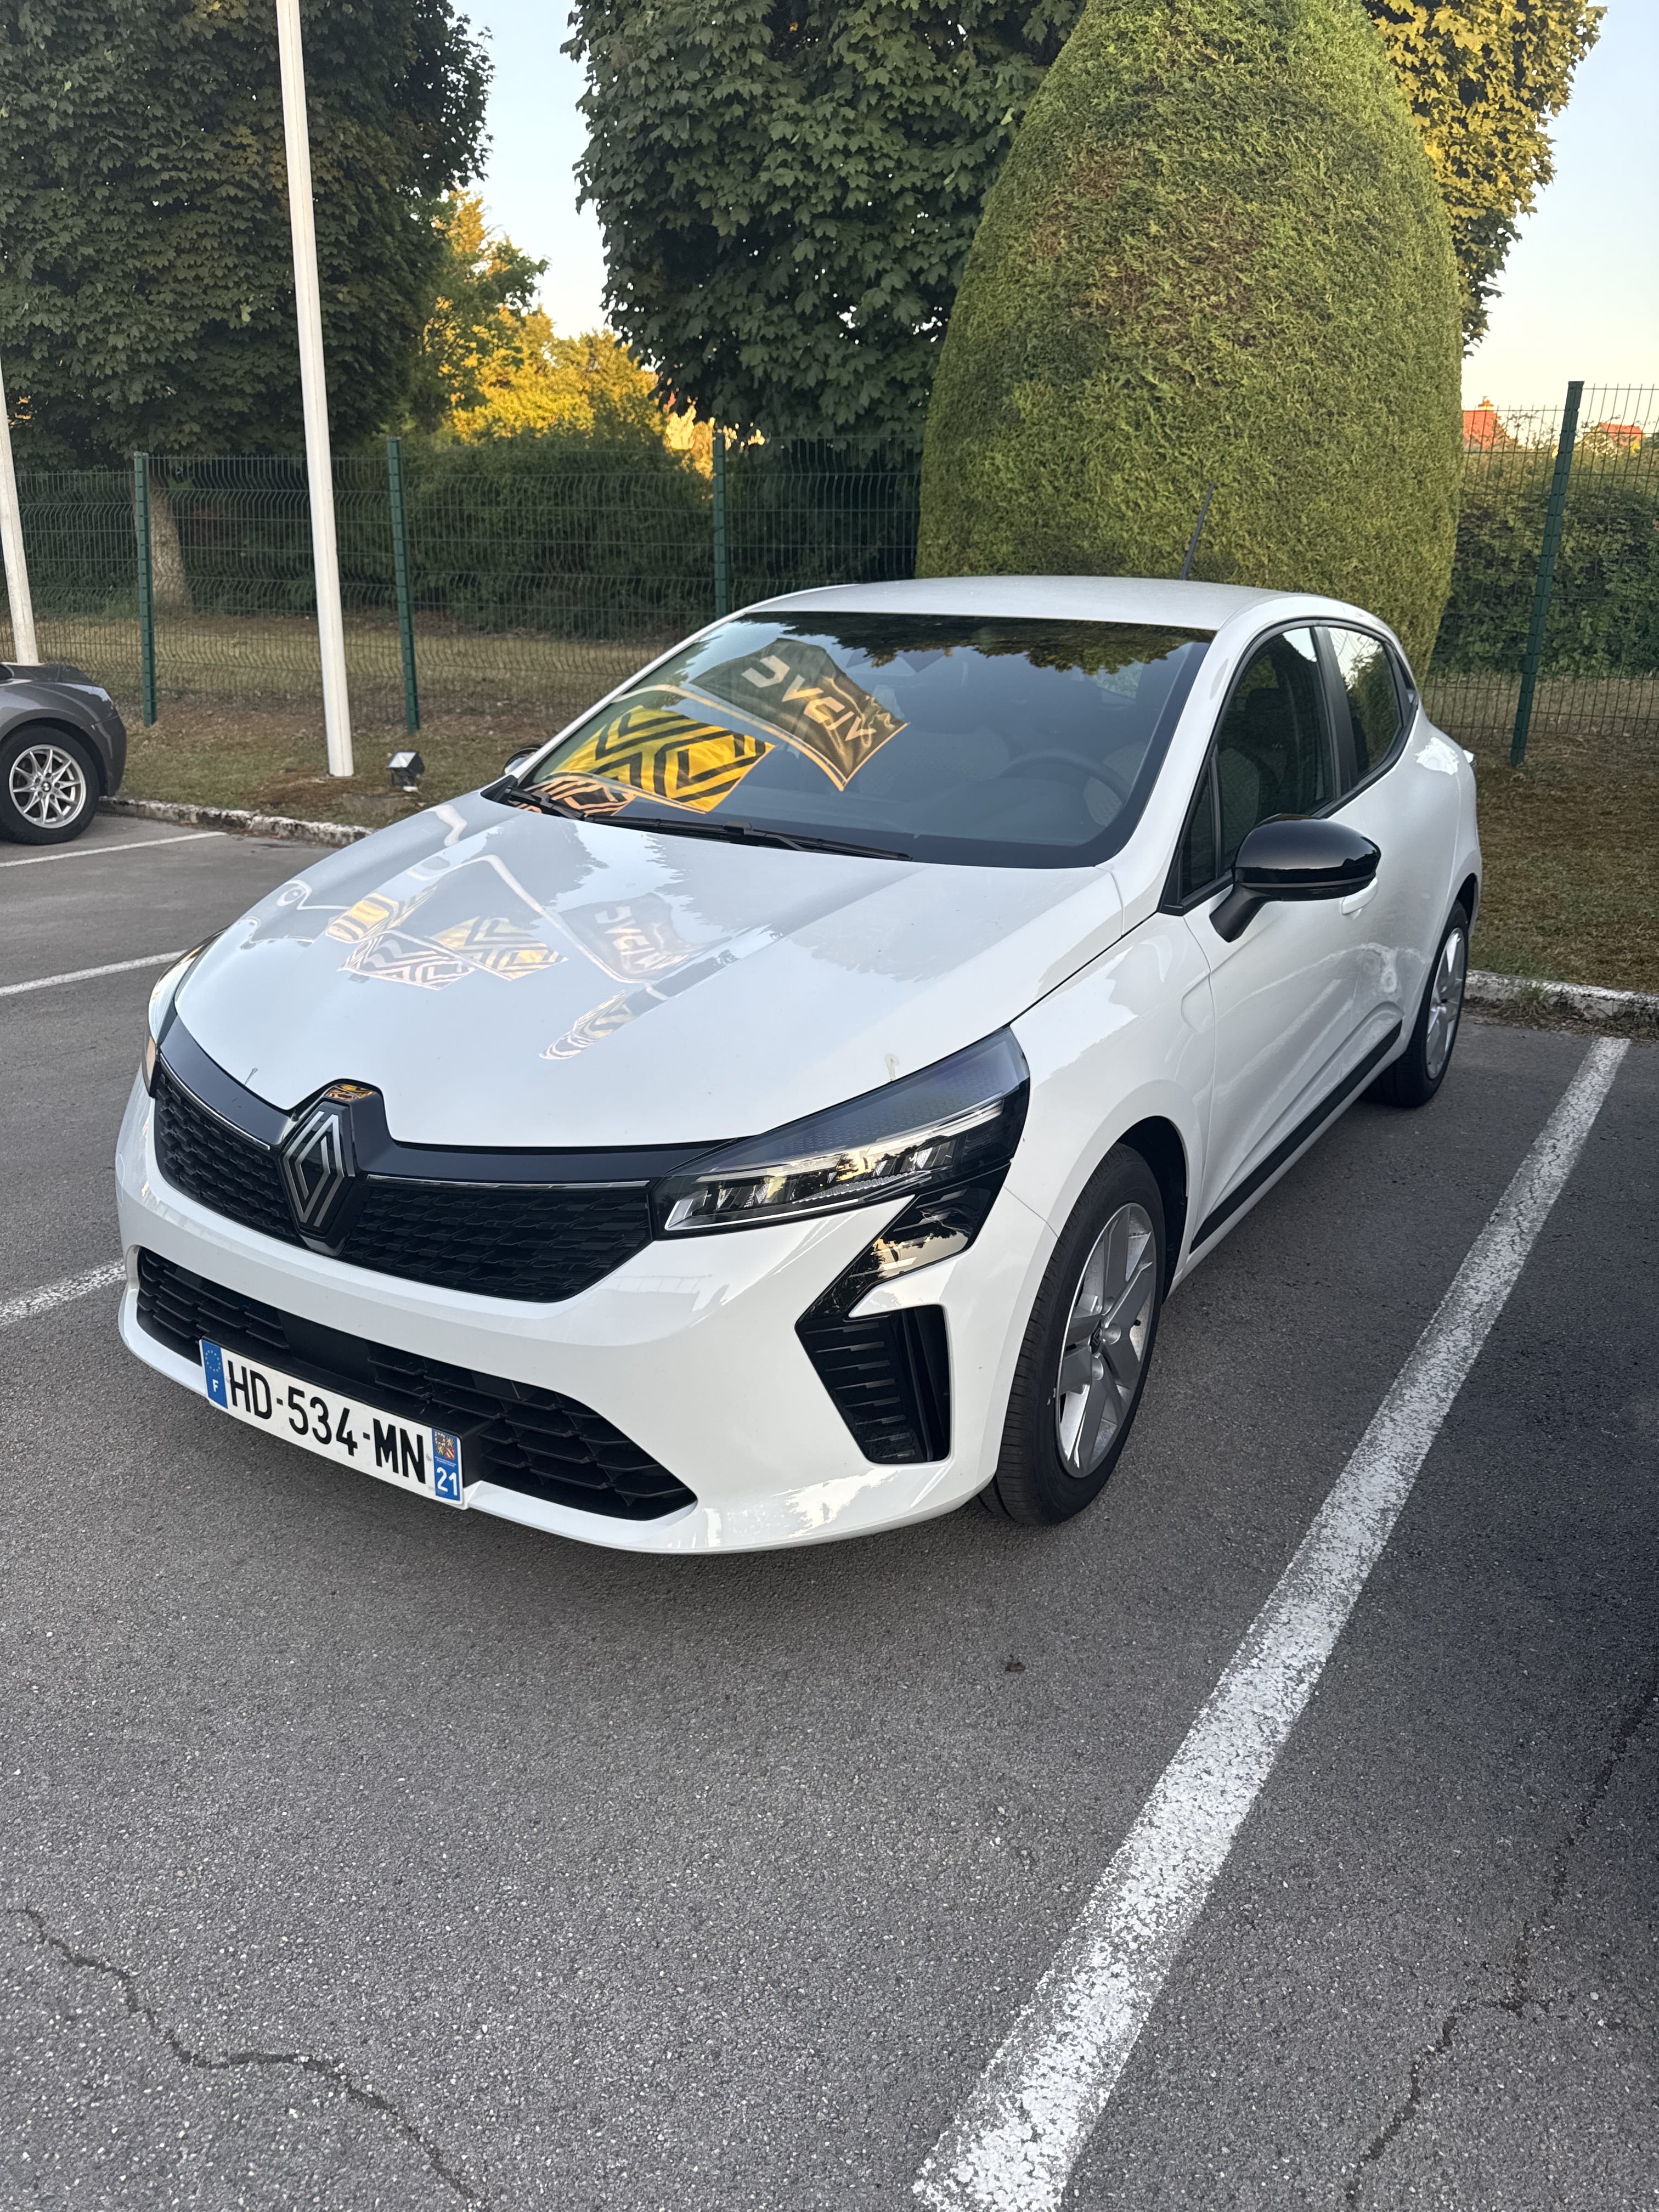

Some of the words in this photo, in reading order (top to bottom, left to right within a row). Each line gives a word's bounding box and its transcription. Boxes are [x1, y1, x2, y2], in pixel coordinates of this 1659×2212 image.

[212, 1378, 219, 1392] F
[227, 1360, 426, 1484] HD-534-MN
[436, 1466, 458, 1496] 21
